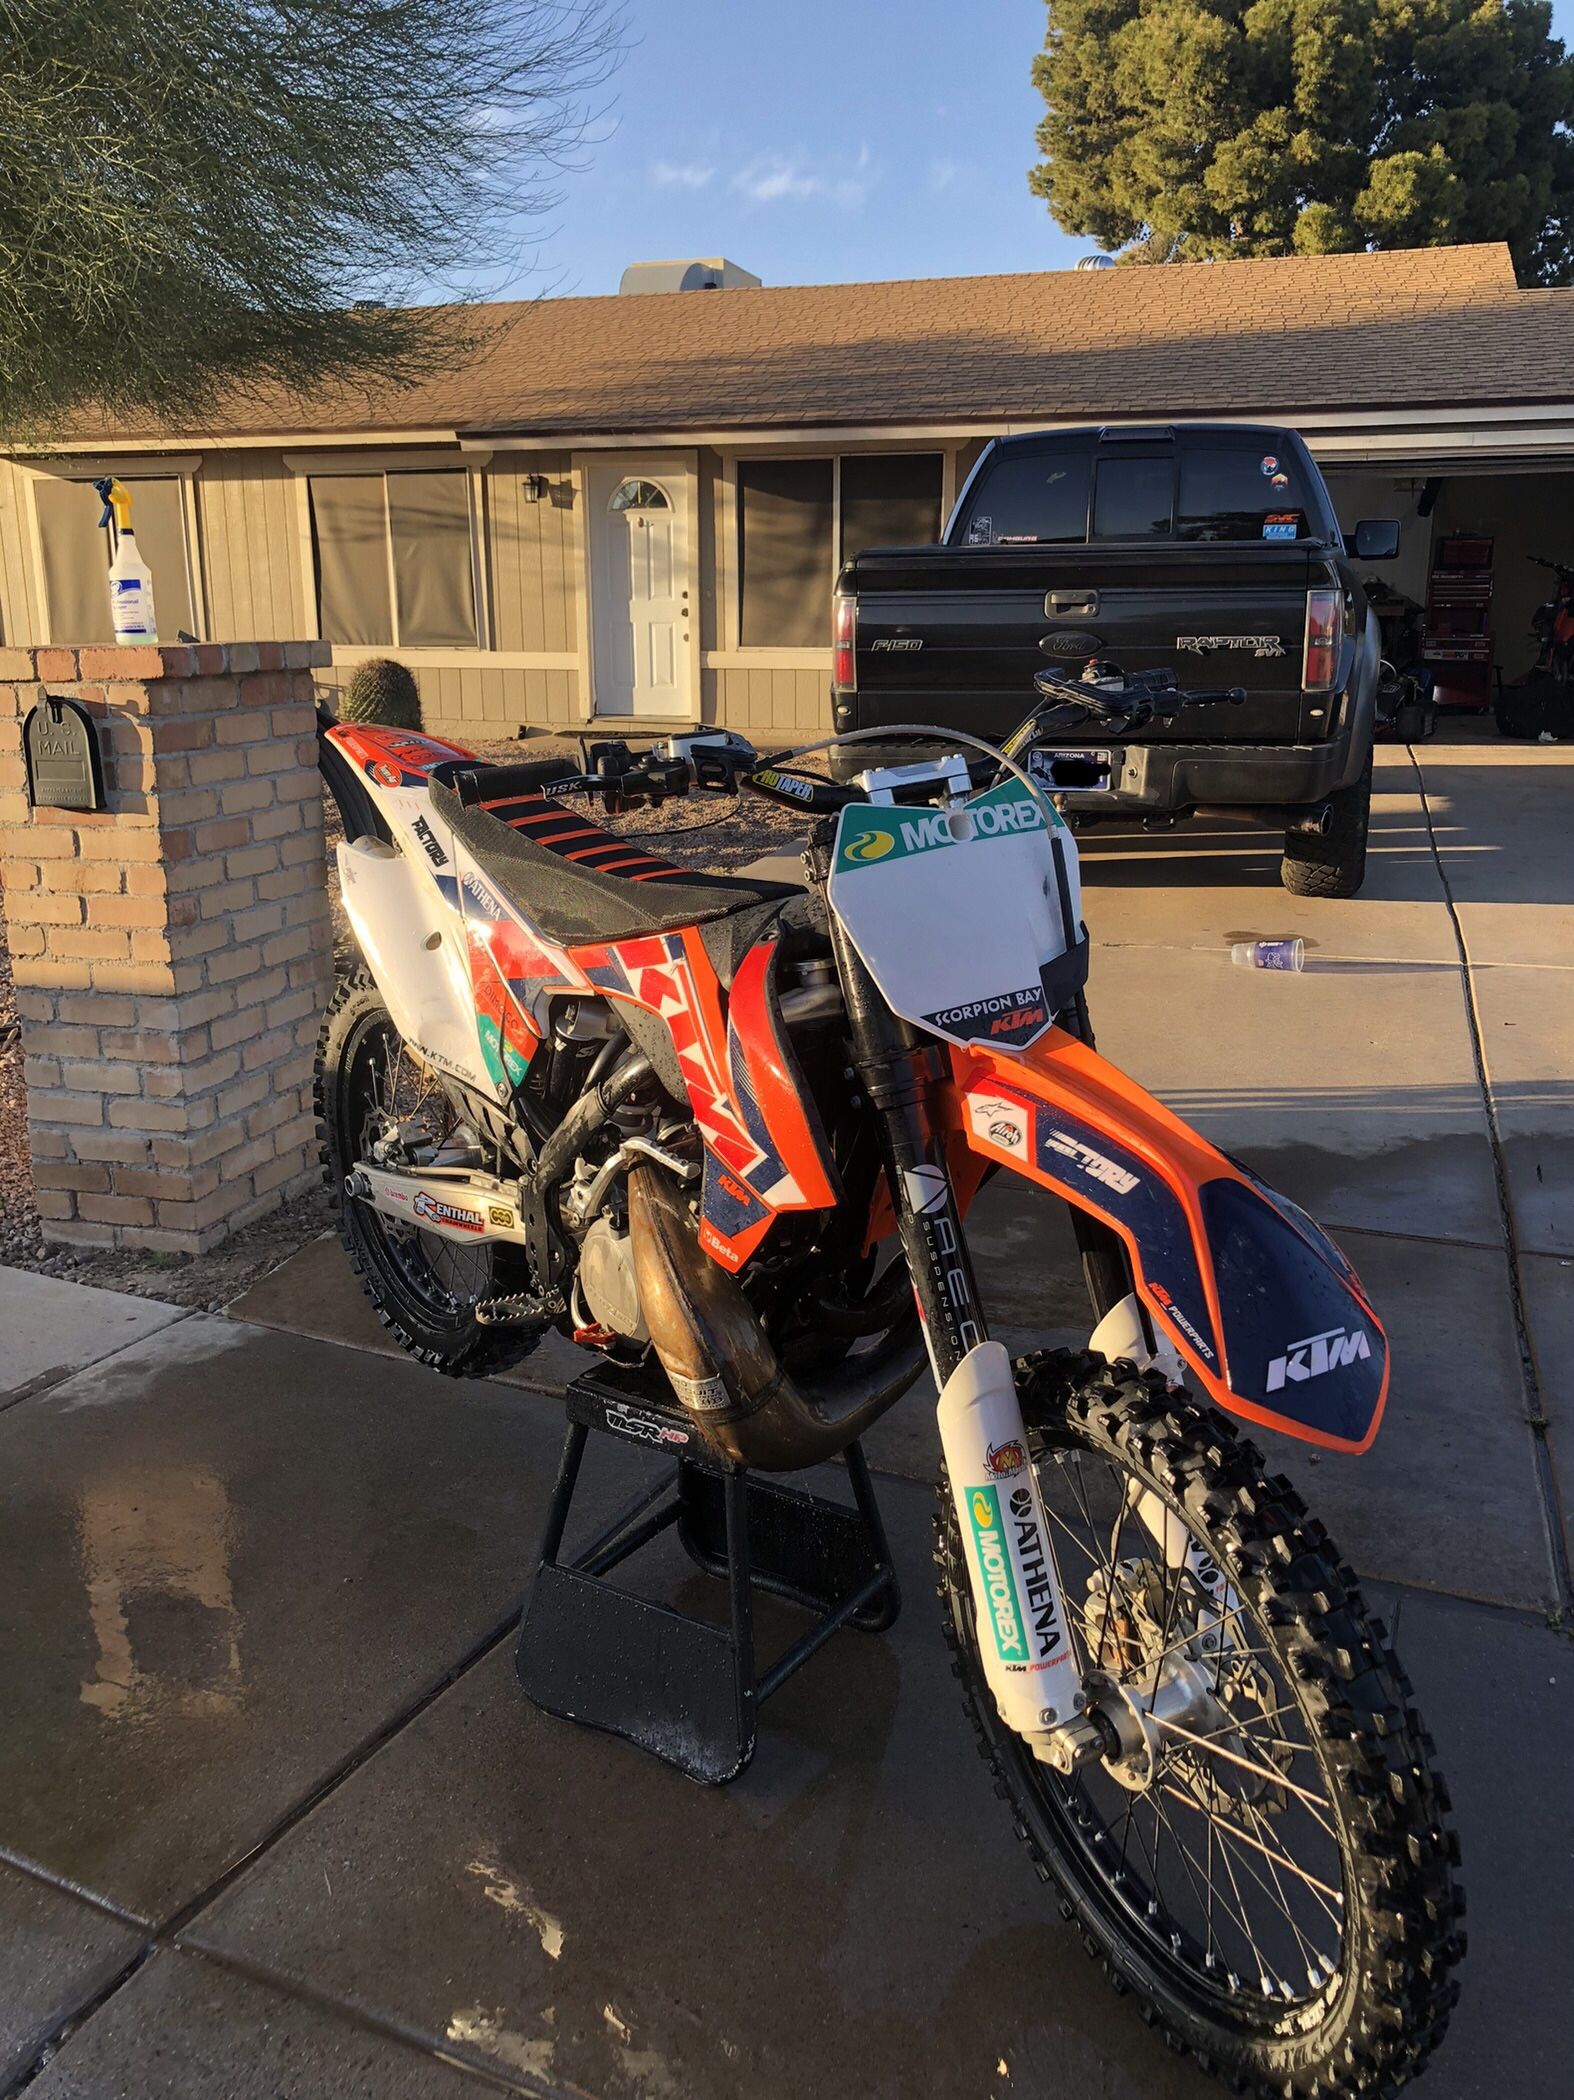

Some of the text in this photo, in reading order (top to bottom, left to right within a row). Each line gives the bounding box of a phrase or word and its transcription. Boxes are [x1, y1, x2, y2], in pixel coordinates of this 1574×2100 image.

[1176, 635, 1286, 655] RAPTOR
[1254, 648, 1282, 657] SVT
[37, 740, 80, 756] MAIL
[546, 781, 580, 796] USK
[411, 814, 450, 867] FACTORY
[899, 799, 1047, 851] MOTOREX
[468, 877, 501, 921] ATHENA
[934, 987, 1042, 1027] SCORPION BAY
[990, 1006, 1045, 1035] KTM
[484, 1030, 522, 1076] MOTREX
[1044, 1128, 1141, 1195] FACTORY
[414, 1191, 483, 1225] RENTHAL
[717, 1174, 751, 1208] KTM
[710, 1235, 739, 1263] Beta
[922, 1220, 963, 1361] SUSPENSION
[1148, 1282, 1215, 1360] KTM POWERPARTS
[1265, 1327, 1371, 1393] KTM
[978, 1530, 1021, 1654] MOTOREX
[1014, 1521, 1061, 1658] ATHENA
[1005, 1664, 1027, 1673] KTM
